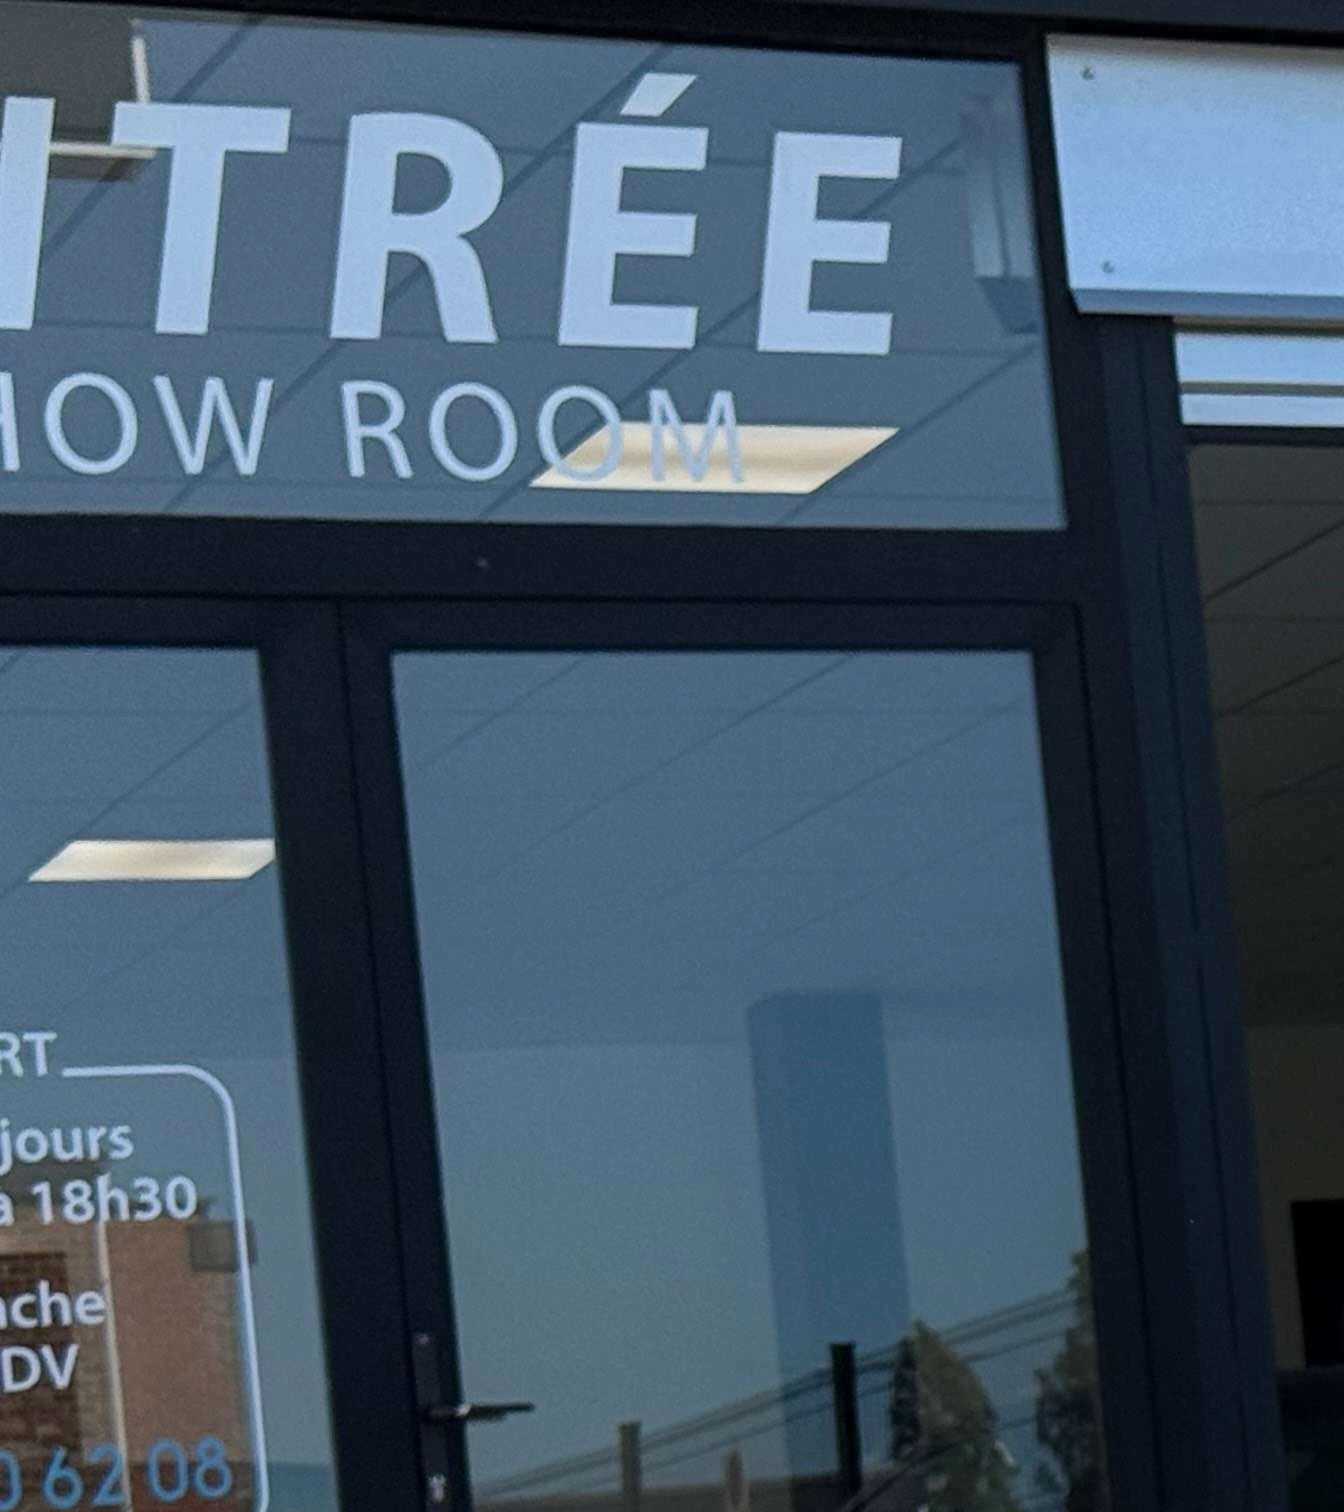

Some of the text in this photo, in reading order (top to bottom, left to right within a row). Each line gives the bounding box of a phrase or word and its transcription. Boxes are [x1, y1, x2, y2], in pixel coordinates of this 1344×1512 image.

[340, 380, 747, 484] ROOM
[32, 1172, 197, 1226] 18h30
[42, 1442, 126, 1509] 62
[148, 1435, 233, 1502] 08
